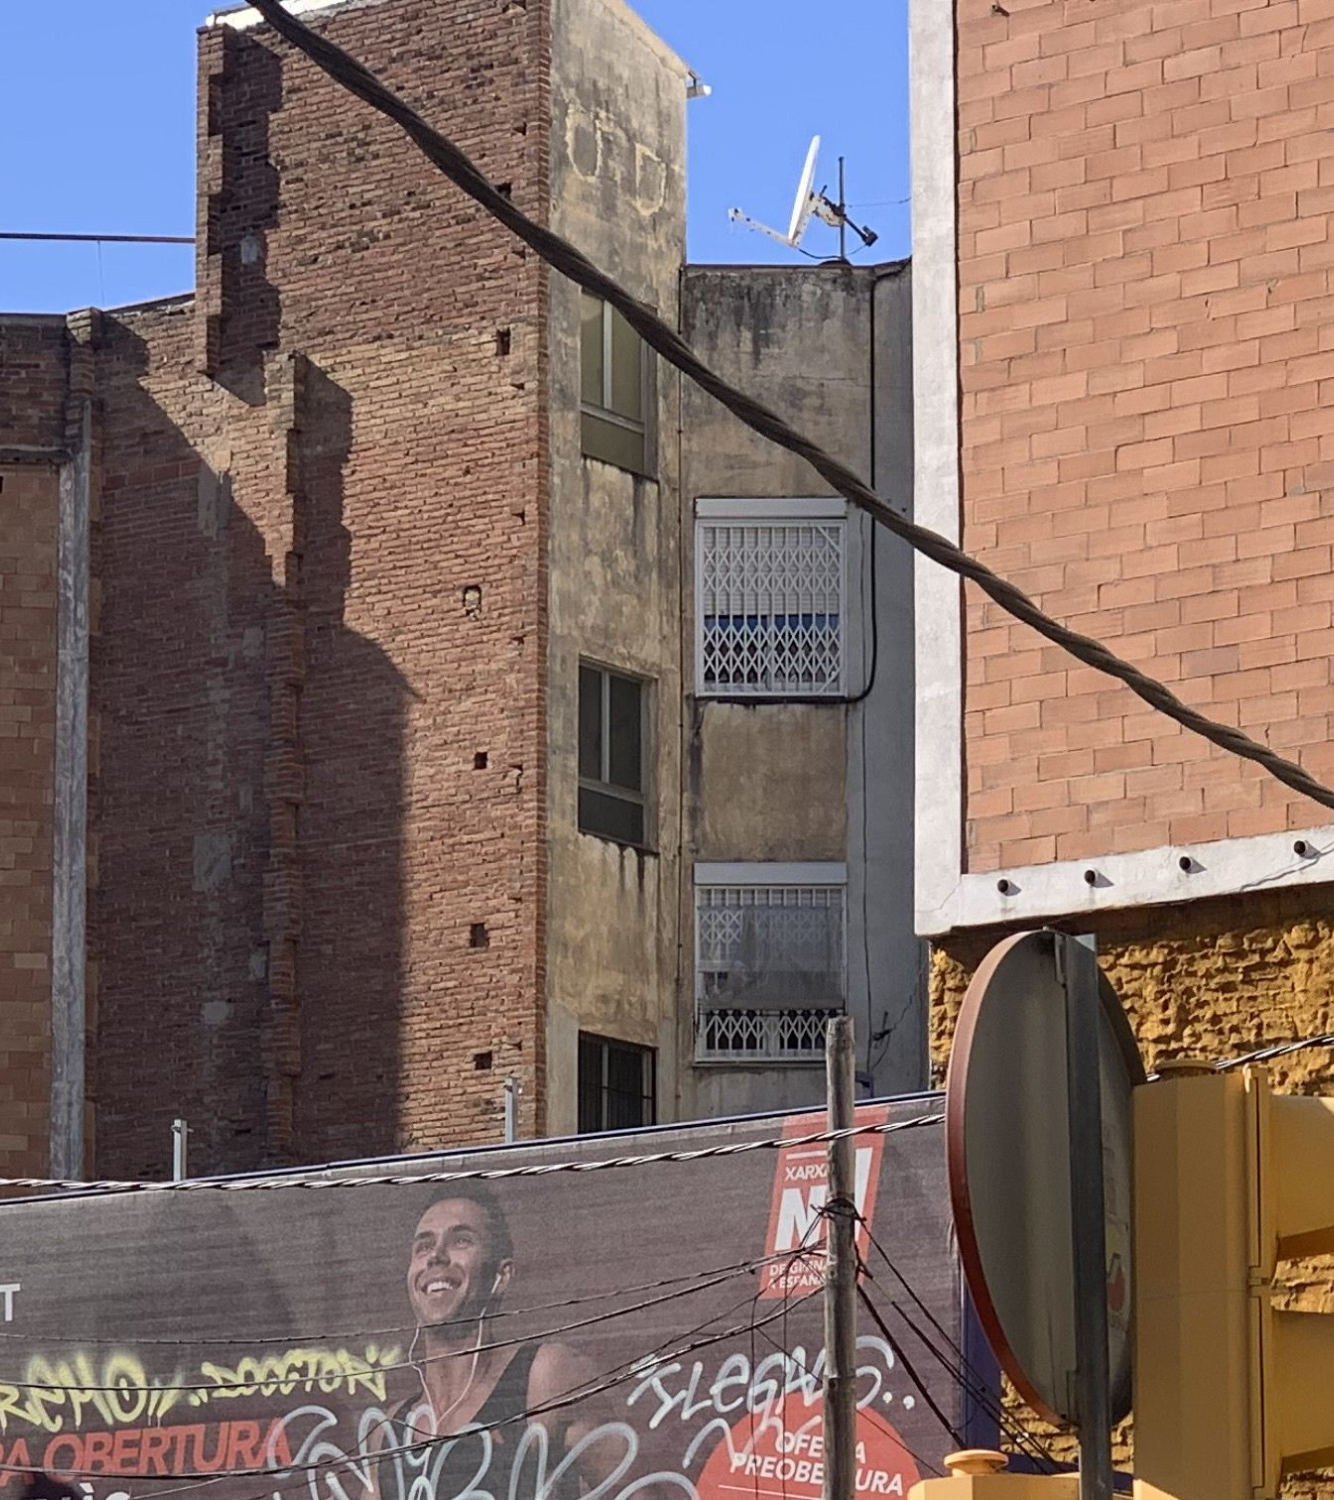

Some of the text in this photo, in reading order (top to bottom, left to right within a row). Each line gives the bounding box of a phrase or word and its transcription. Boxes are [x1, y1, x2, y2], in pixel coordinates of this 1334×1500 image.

[785, 1163, 828, 1181] XARX
[42, 1416, 295, 1486] OBERTURA
[775, 1431, 866, 1465] OFEA
[729, 1452, 904, 1497] PREOBEURA
